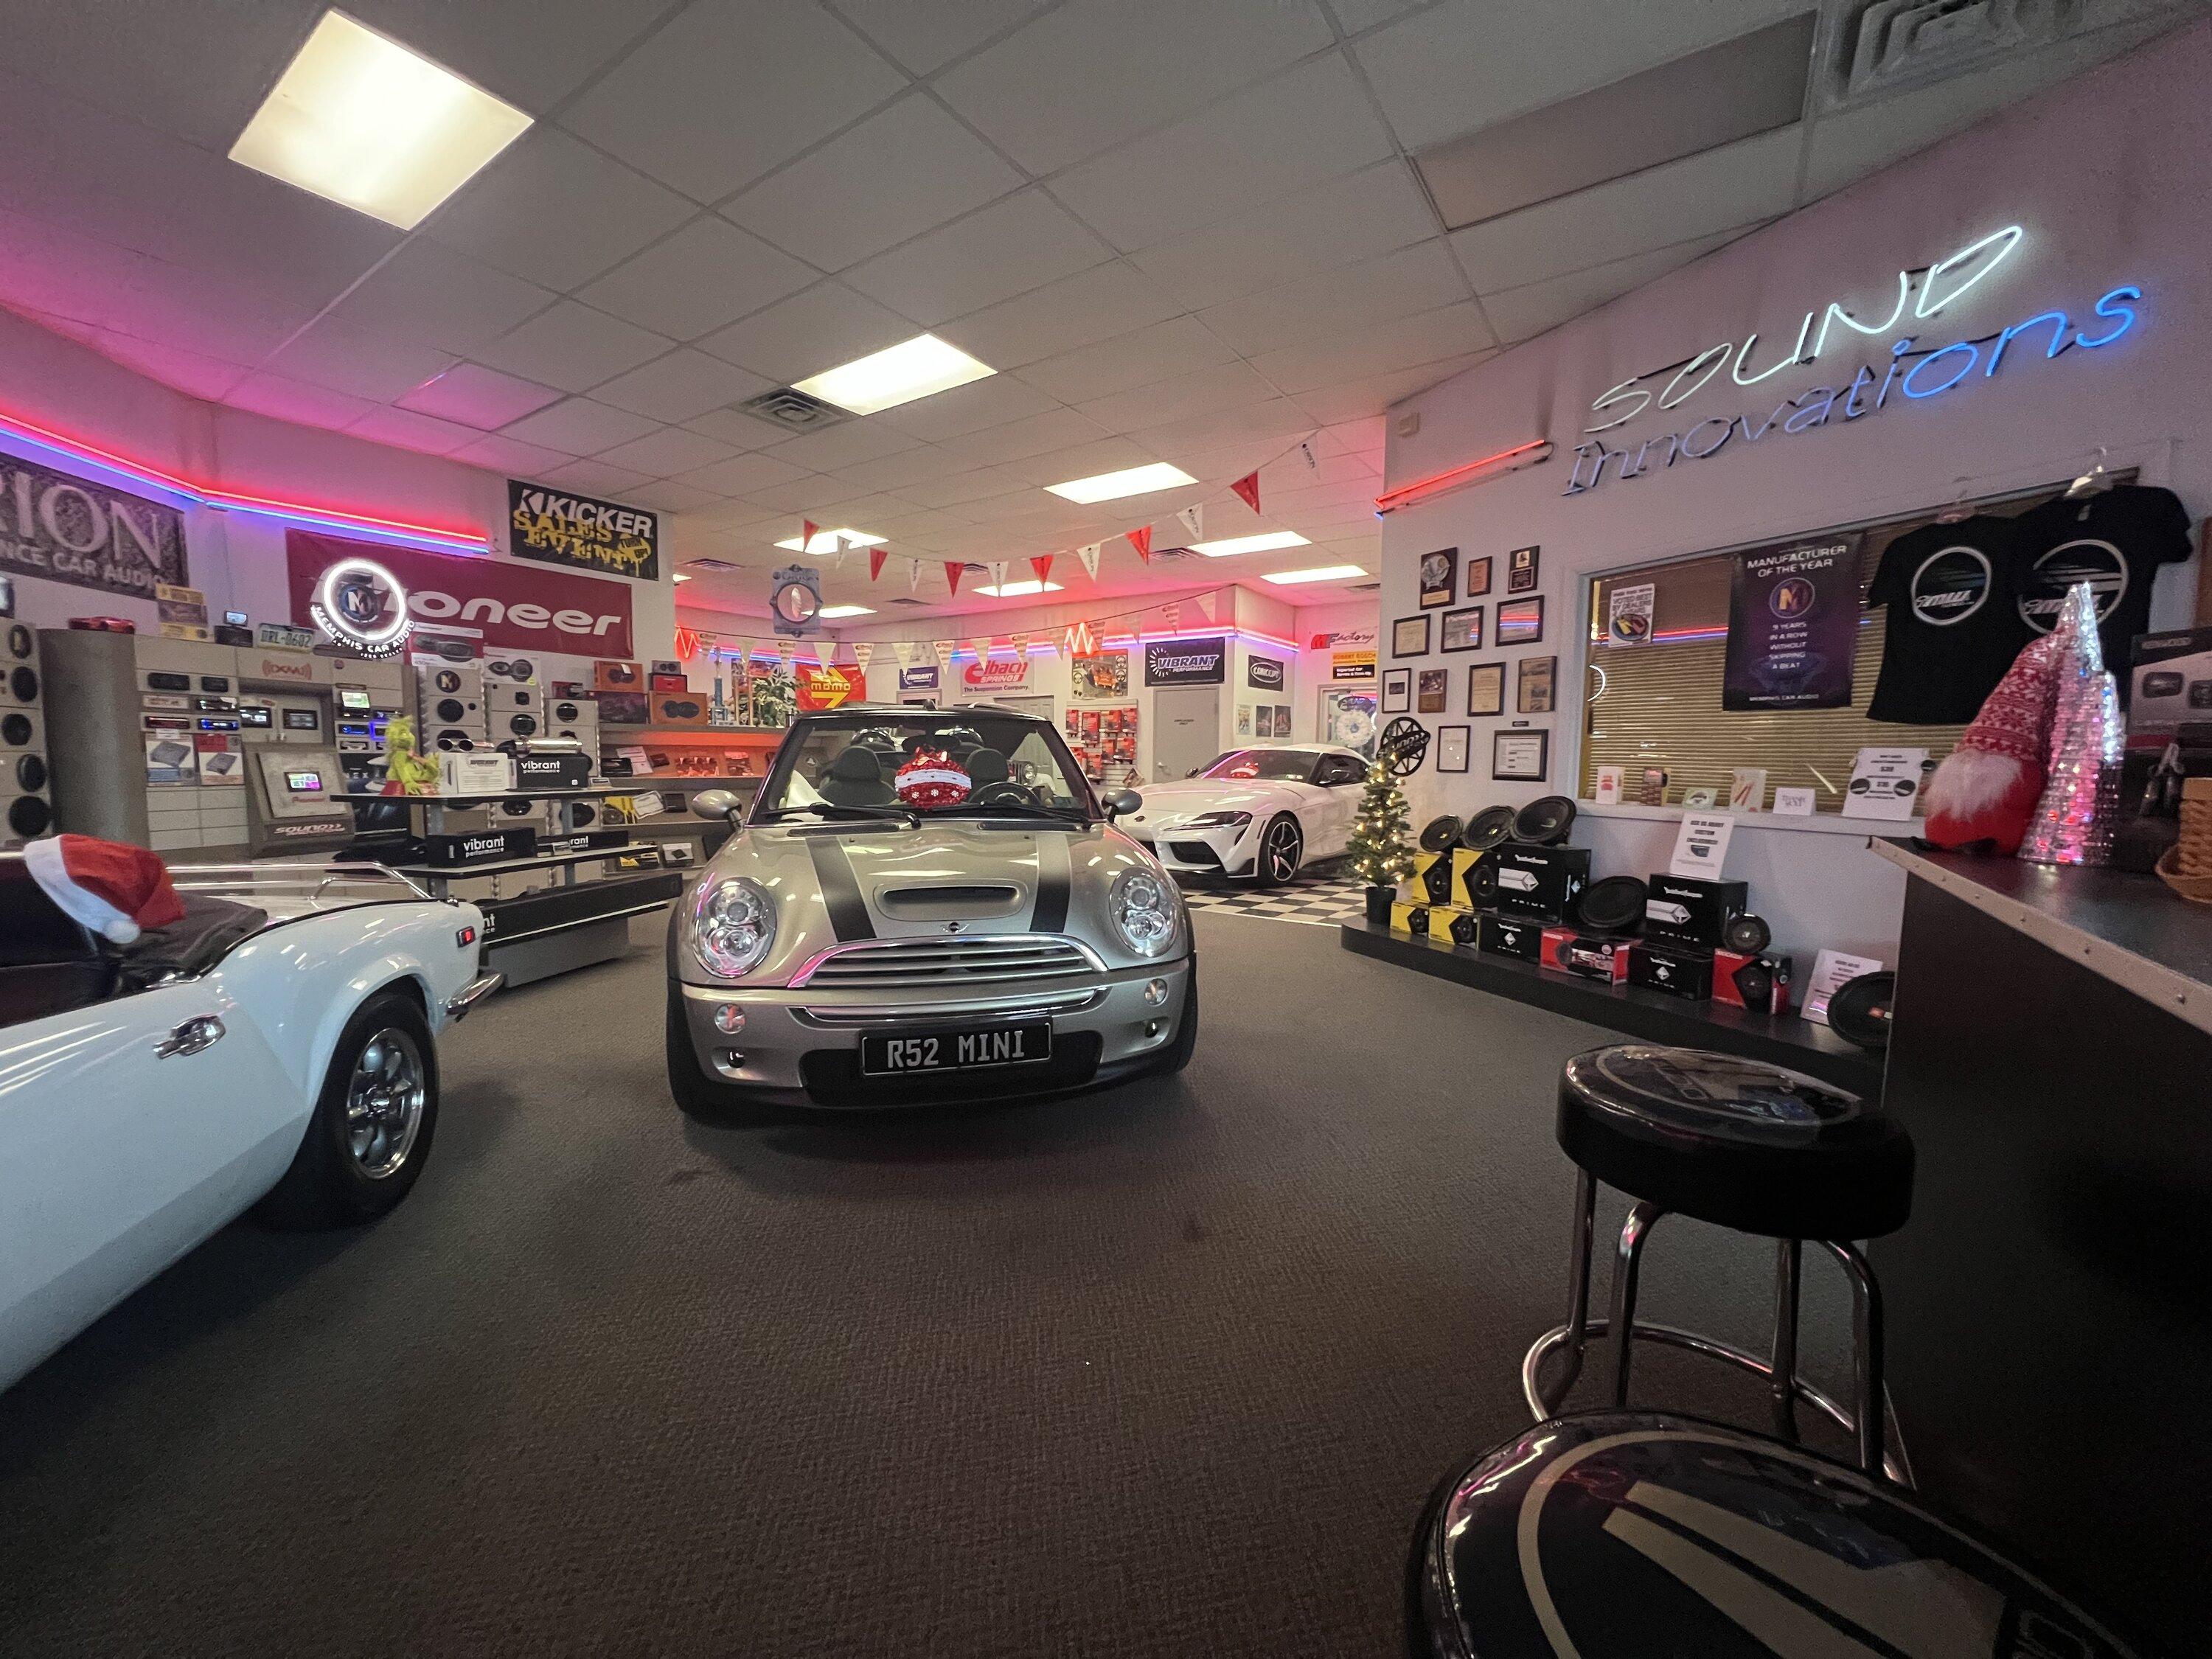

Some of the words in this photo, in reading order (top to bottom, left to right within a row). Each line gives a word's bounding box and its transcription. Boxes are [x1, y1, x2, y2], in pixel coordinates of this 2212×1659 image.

[1584, 225, 2023, 434] SOUND
[546, 495, 653, 539] KICKER
[1747, 545, 1848, 569] MANUFACTURER
[52, 552, 97, 577] CAR
[1758, 567, 1774, 578] OF
[1775, 564, 1798, 576] THE
[1801, 557, 1834, 571] YEAR
[311, 605, 363, 652] MEMPHIS
[367, 644, 391, 654] CAR
[392, 619, 416, 650] AUDIO
[1780, 622, 1807, 630] YEARS
[1786, 631, 1809, 639] ROW
[1770, 641, 1806, 650] WITHOUT
[1769, 651, 1806, 660] SKIPPING
[1158, 655, 1220, 669] VIBRANT
[1172, 665, 1214, 673] PERFORMANCE
[980, 674, 1020, 684] SPRINGS
[521, 760, 560, 770] vibrant
[463, 835, 504, 851] vibrant
[569, 835, 589, 847] rant
[1512, 898, 1546, 908] PRIME
[1660, 931, 1700, 942] PRIME
[887, 1037, 939, 1068] R52
[958, 1030, 1026, 1063] MINI
